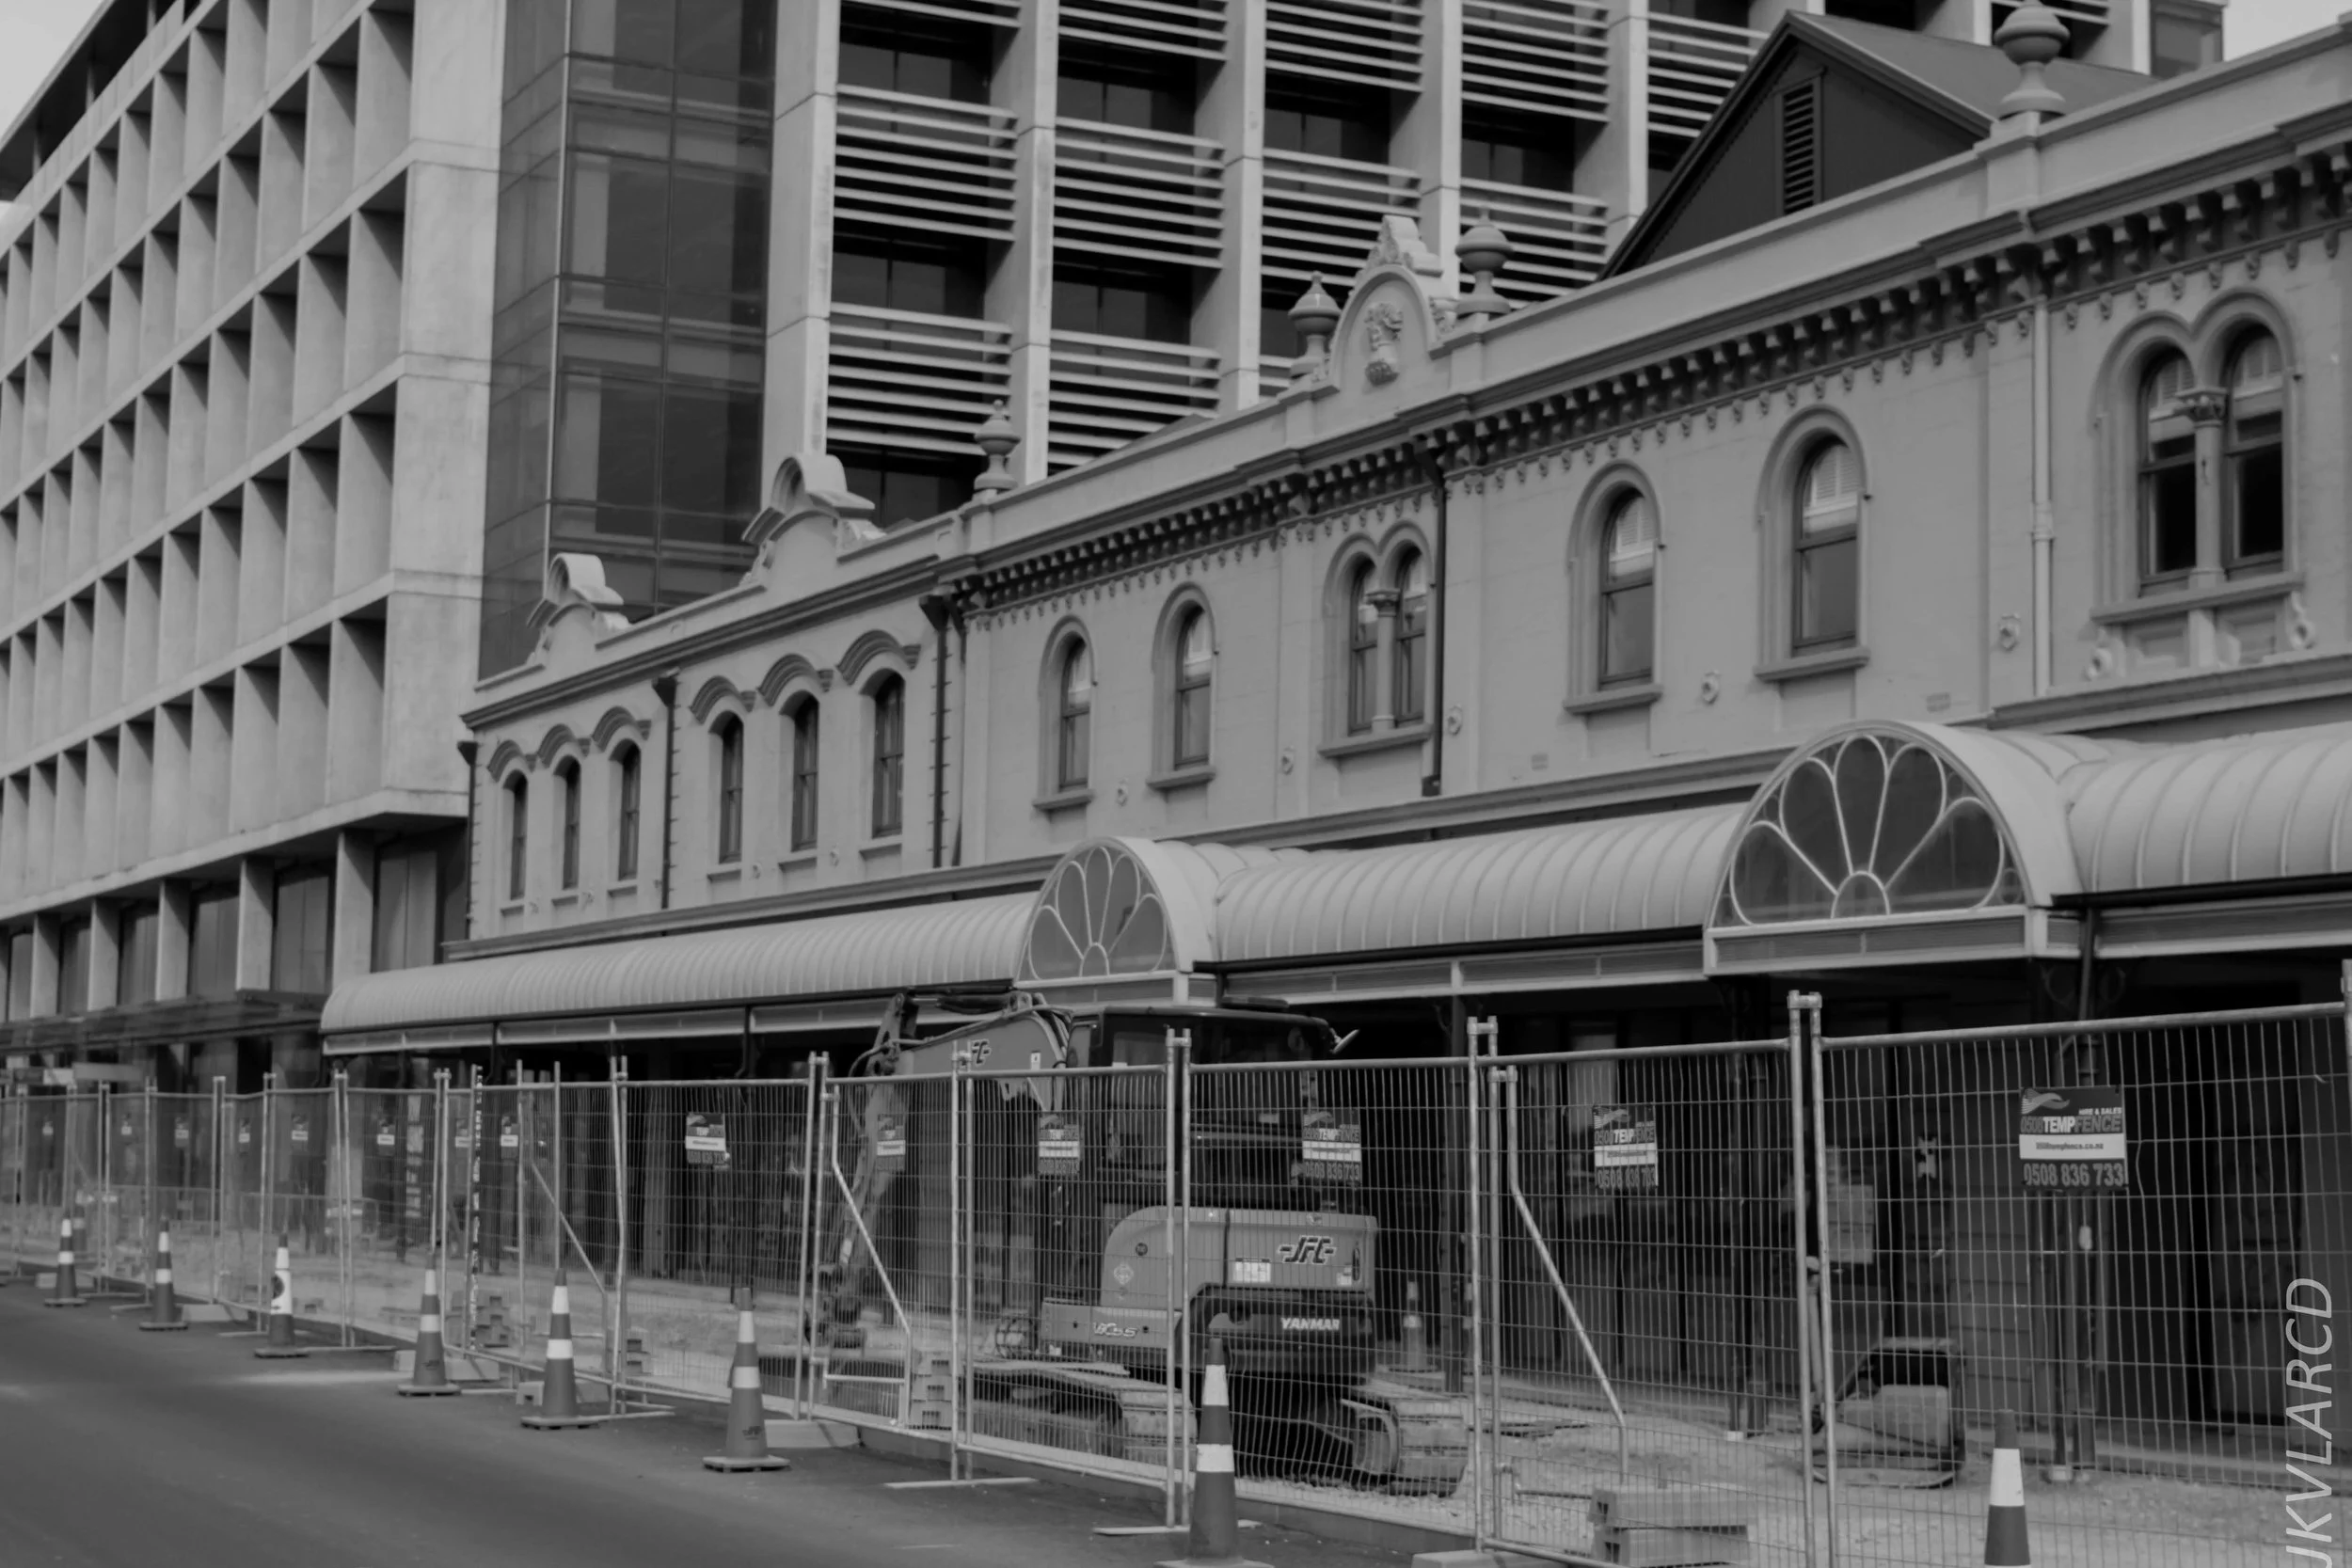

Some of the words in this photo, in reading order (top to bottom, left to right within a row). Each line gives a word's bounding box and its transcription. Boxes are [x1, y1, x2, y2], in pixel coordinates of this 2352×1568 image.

[2024, 1163, 2058, 1186] 0508
[2060, 1163, 2090, 1186] 836
[2092, 1163, 2124, 1186] 733
[1280, 1317, 1341, 1331] YANMAR
